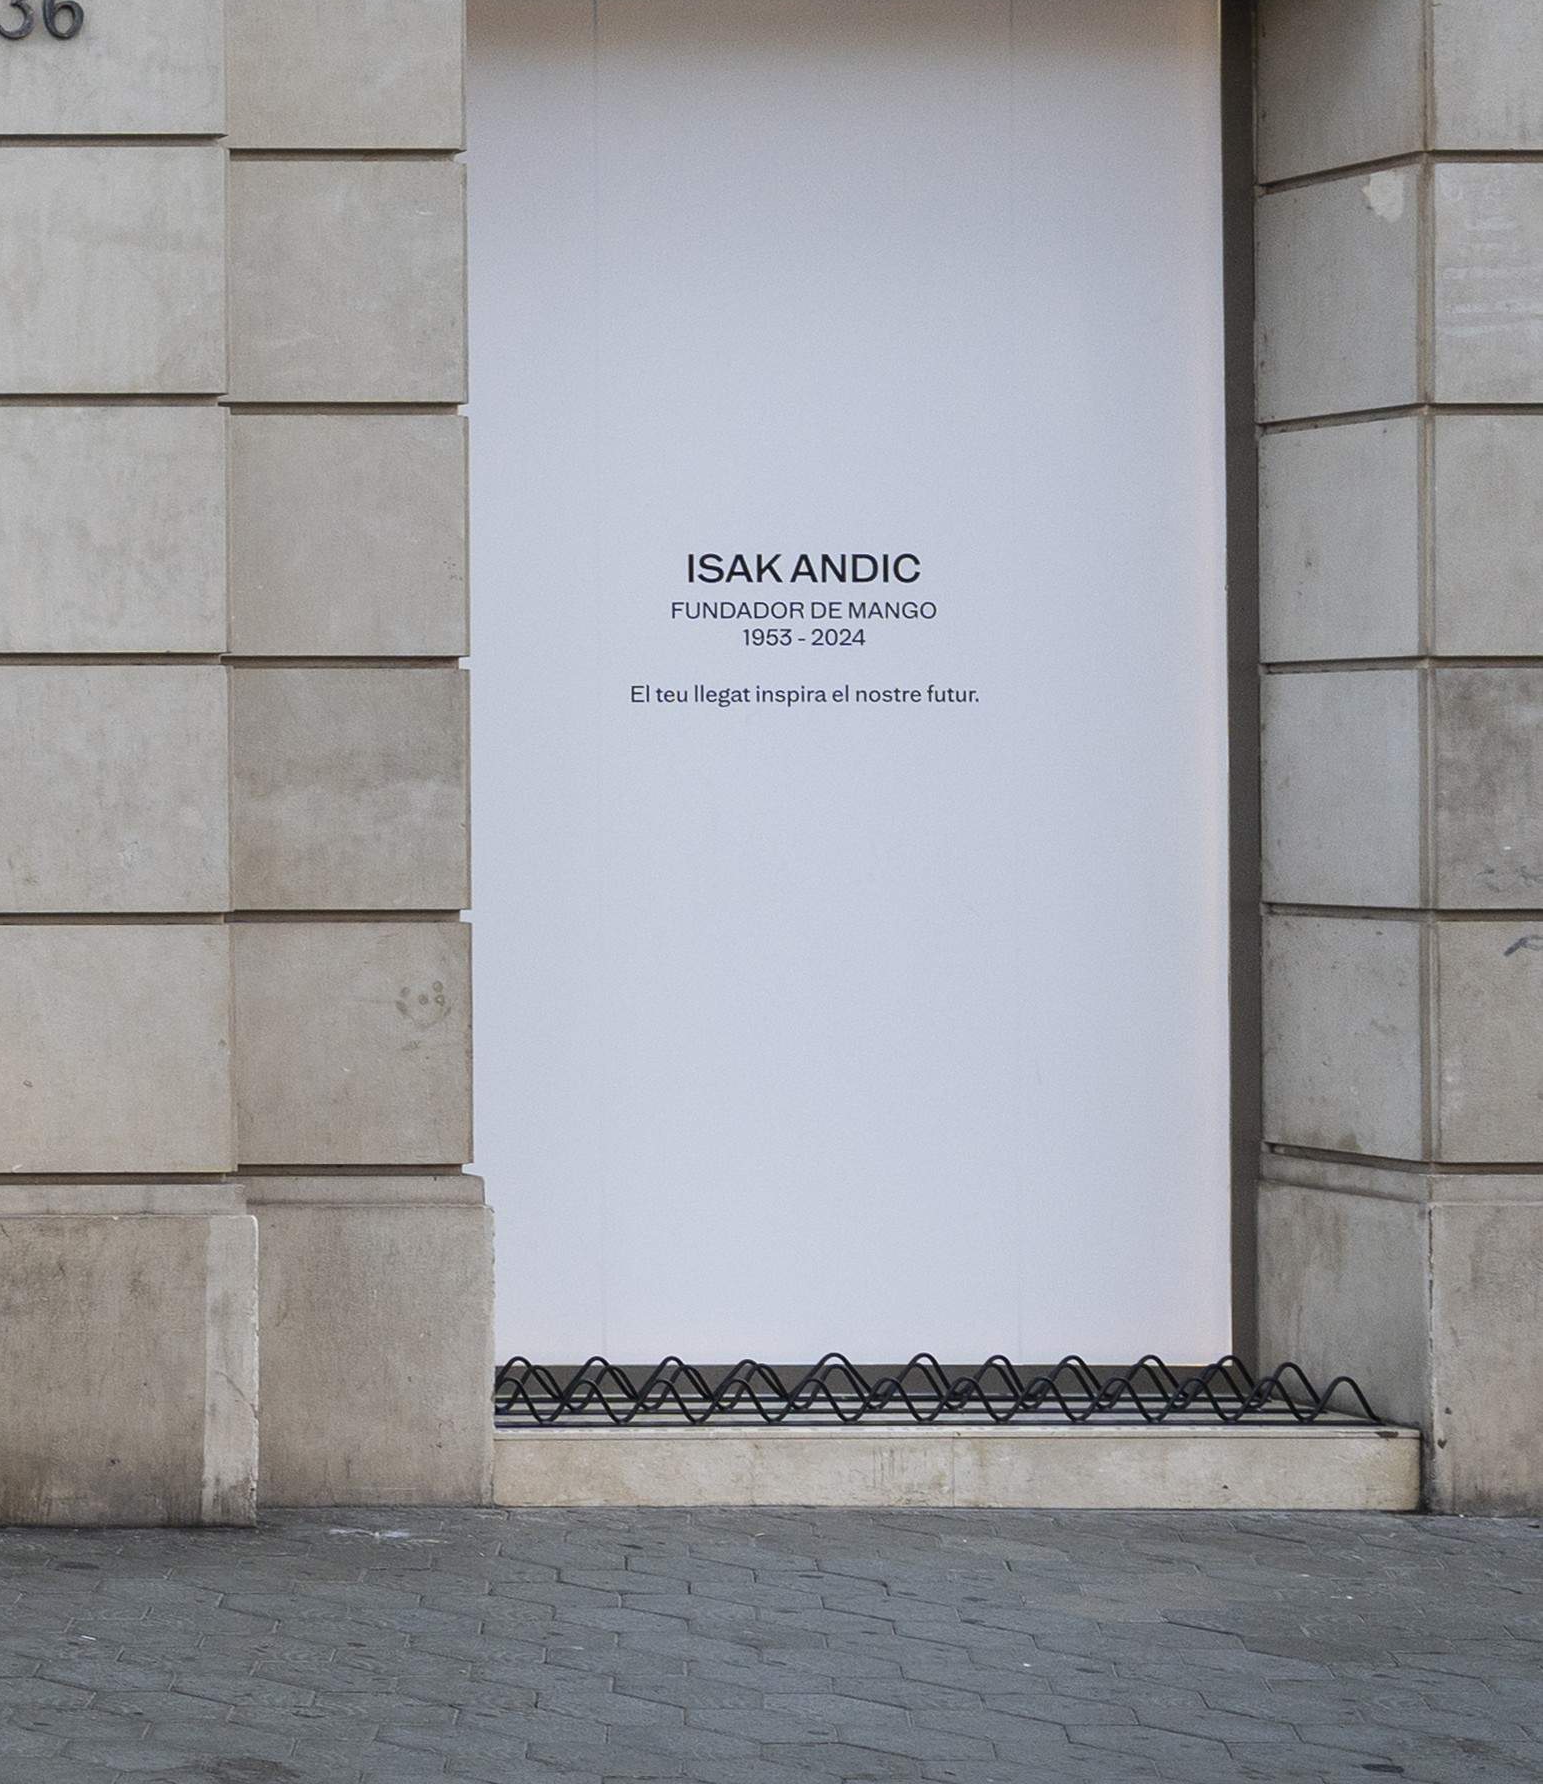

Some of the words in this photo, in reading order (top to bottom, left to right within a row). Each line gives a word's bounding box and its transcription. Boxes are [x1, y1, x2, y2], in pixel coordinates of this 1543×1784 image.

[687, 552, 784, 584] ISAK
[789, 552, 922, 584] ANDIC
[670, 601, 805, 620] FUNDADOR
[811, 601, 843, 620] DE
[848, 601, 938, 620] MANGO
[742, 628, 793, 646] 1953
[811, 628, 867, 646] 2024
[630, 684, 651, 703] El
[655, 687, 689, 703] teu
[694, 684, 752, 708] llegat
[756, 684, 828, 707] inspira
[831, 684, 850, 703] el
[855, 687, 922, 703] nostre
[926, 684, 980, 703] futur.
